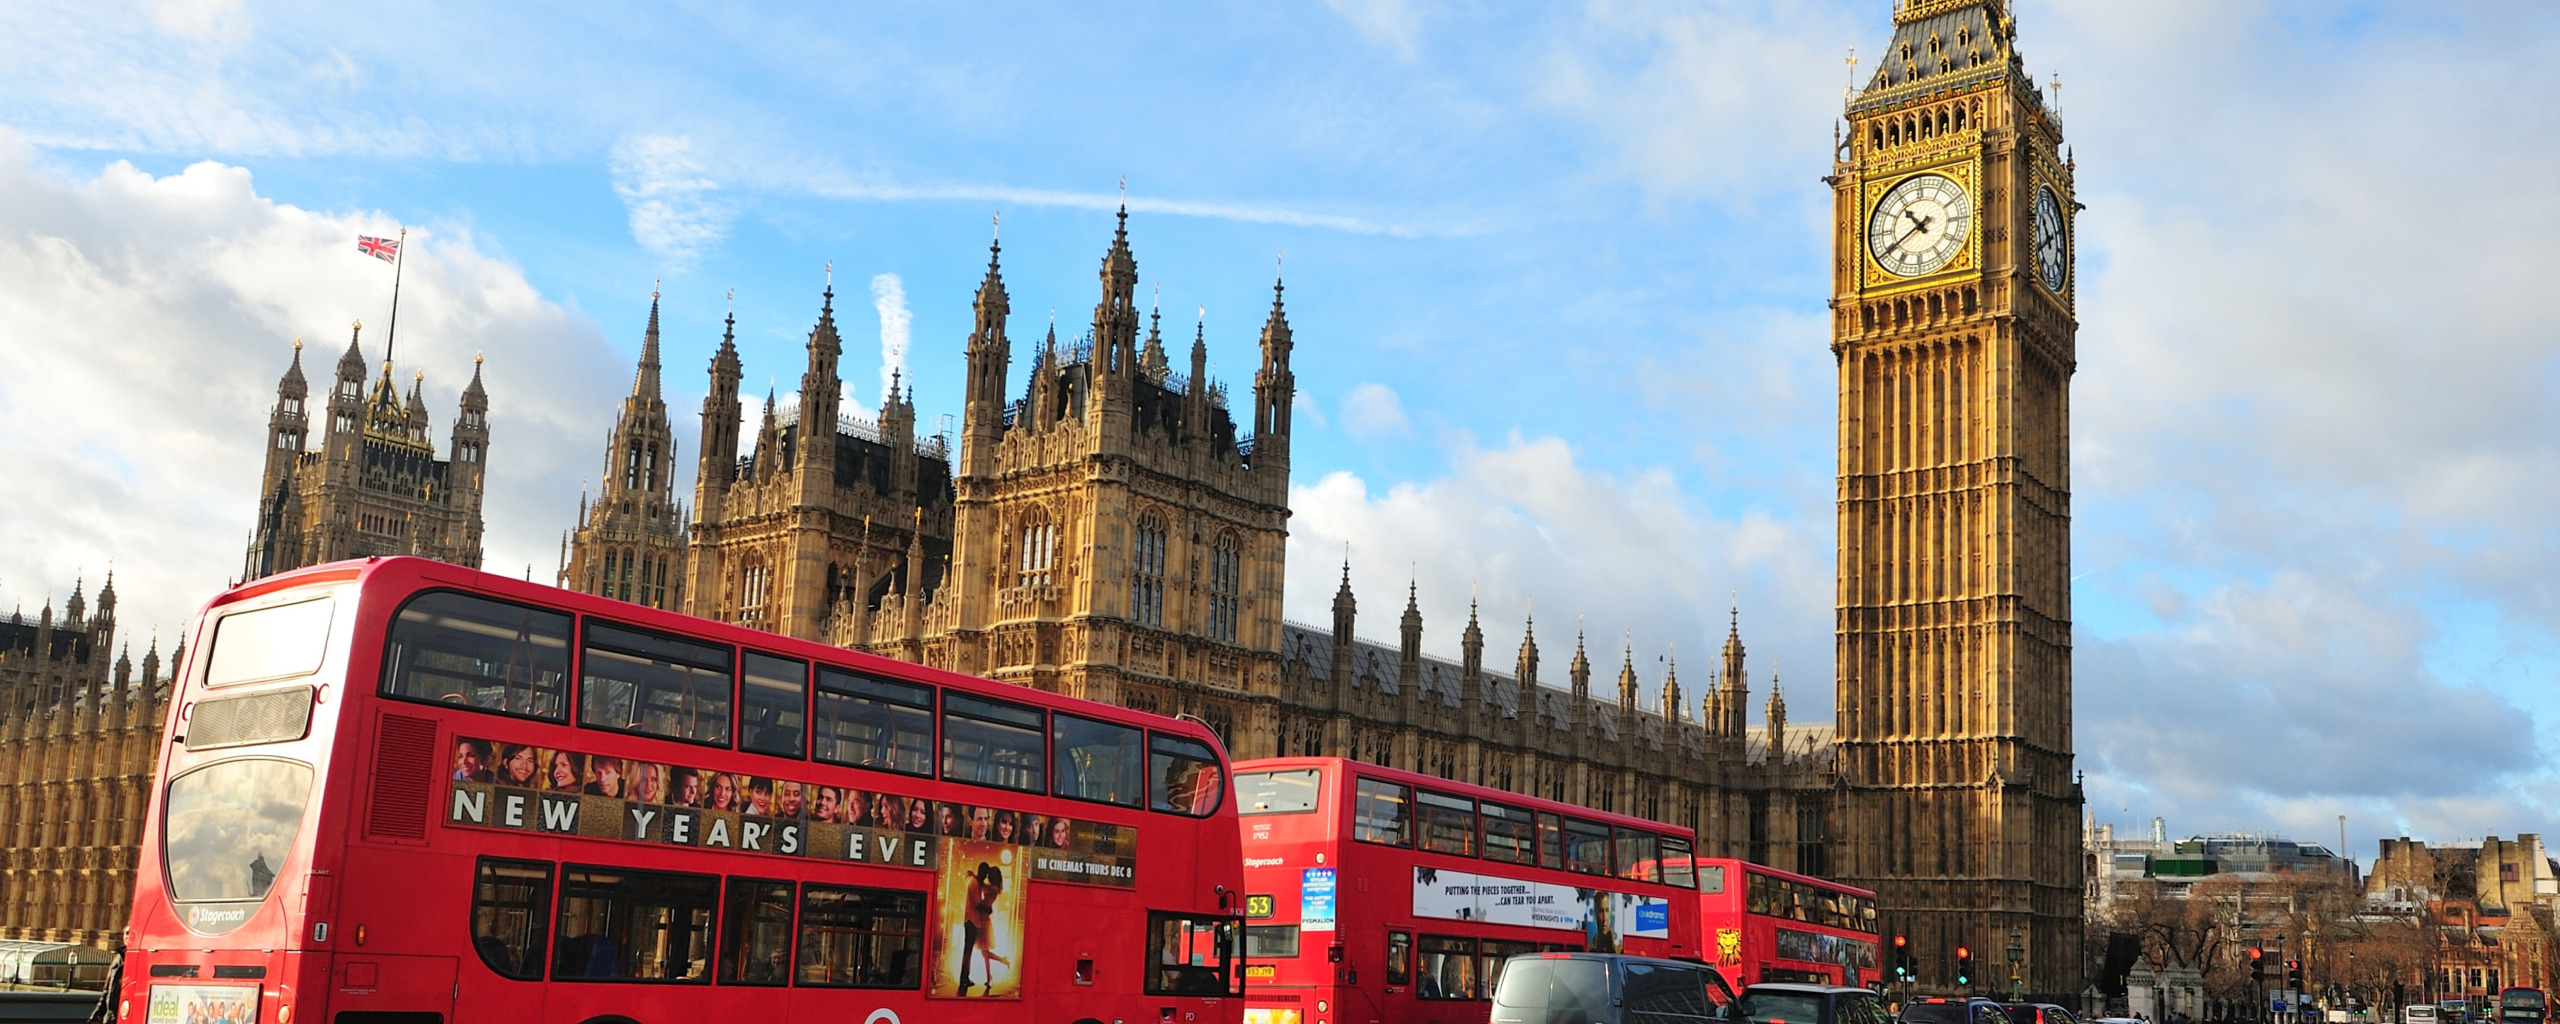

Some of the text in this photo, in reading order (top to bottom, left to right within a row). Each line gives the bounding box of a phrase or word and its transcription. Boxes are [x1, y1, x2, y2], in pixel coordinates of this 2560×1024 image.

[452, 789, 926, 866] NEW YEAR'S EVE
[1037, 858, 1132, 878] IN CINEMAS THURS DEC 8
[1244, 857, 1283, 868] Stagecoach
[1445, 886, 1469, 895] PUTTING
[1471, 886, 1481, 895] THE
[1482, 886, 1499, 895] PIECES
[1512, 896, 1524, 905] TEAR
[1526, 896, 1536, 905] YOU
[1537, 896, 1555, 905] APART.
[200, 908, 245, 925] Stagecoach
[1531, 913, 1559, 923] WEEKNIGHTS
[1247, 967, 1259, 975] X53
[152, 994, 180, 1017] ideal
